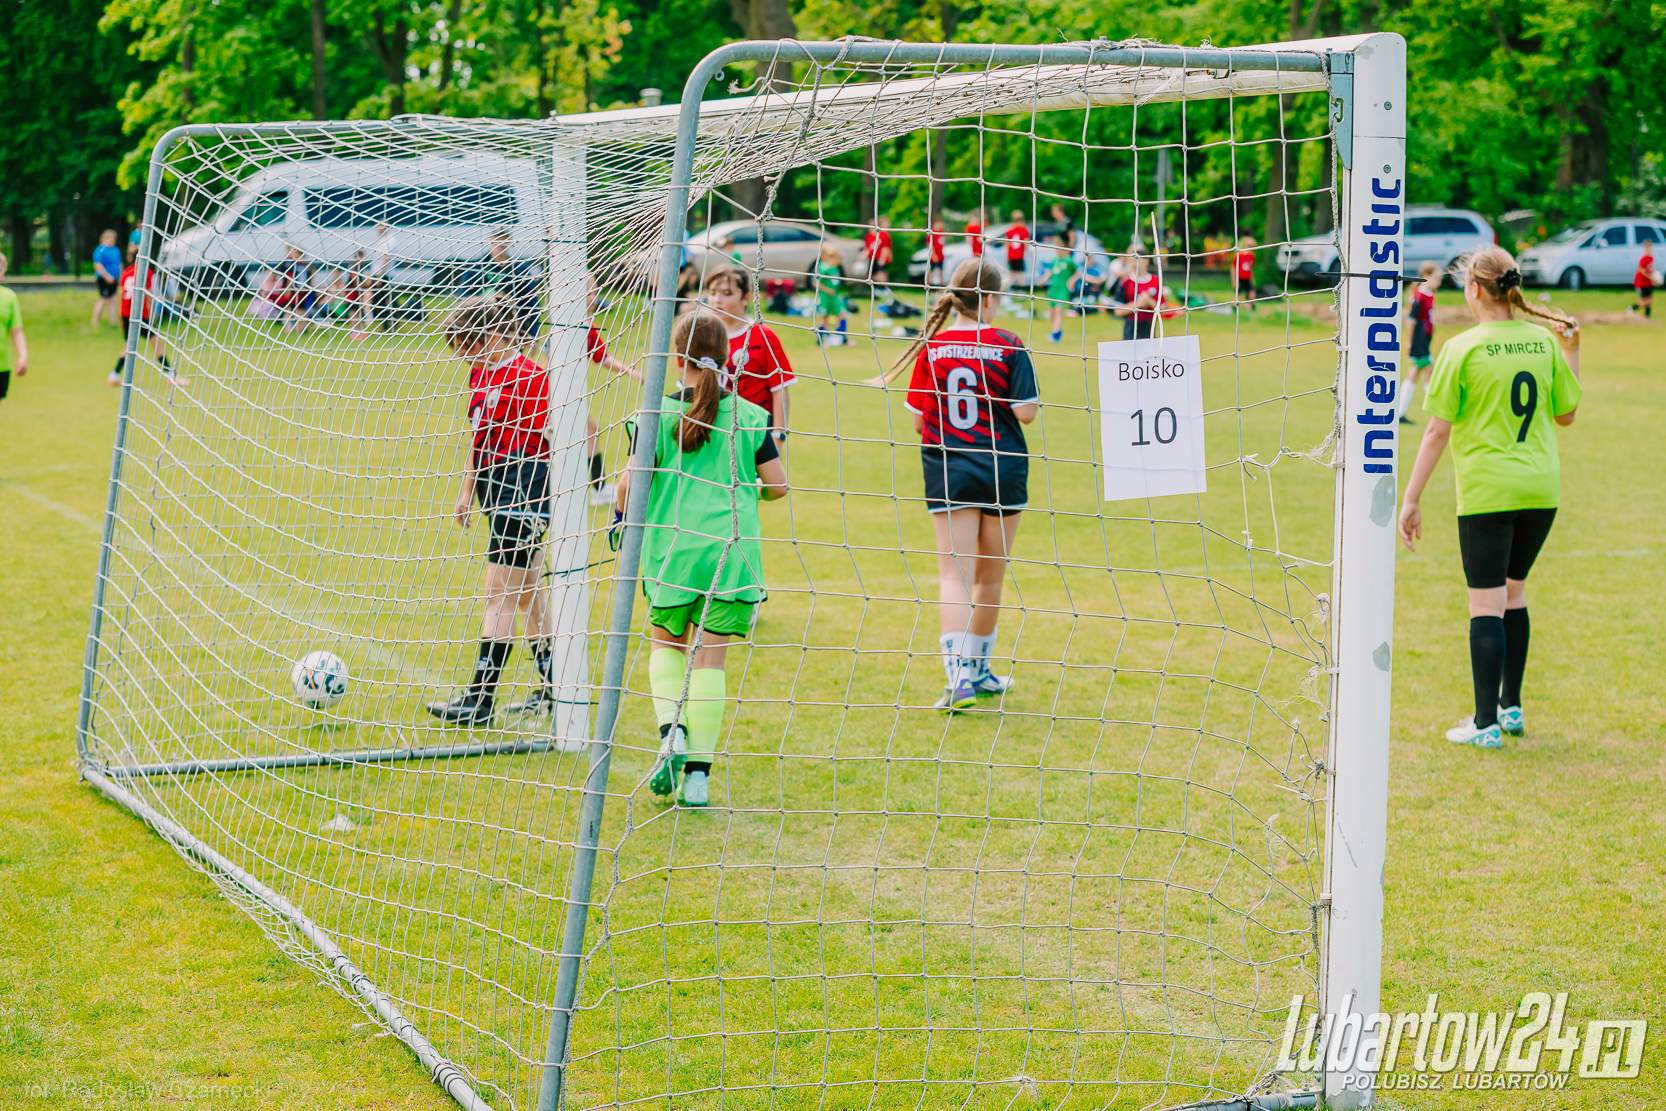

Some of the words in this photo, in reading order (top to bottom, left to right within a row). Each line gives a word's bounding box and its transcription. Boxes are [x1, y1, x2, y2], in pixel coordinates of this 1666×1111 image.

[1357, 177, 1401, 474] interplastic
[1486, 344, 1502, 357] SP
[1505, 342, 1546, 355] MIRCZE
[1118, 358, 1185, 382] Boisko
[946, 366, 979, 430] 6
[1510, 370, 1538, 443] 9
[1130, 406, 1178, 446] 10
